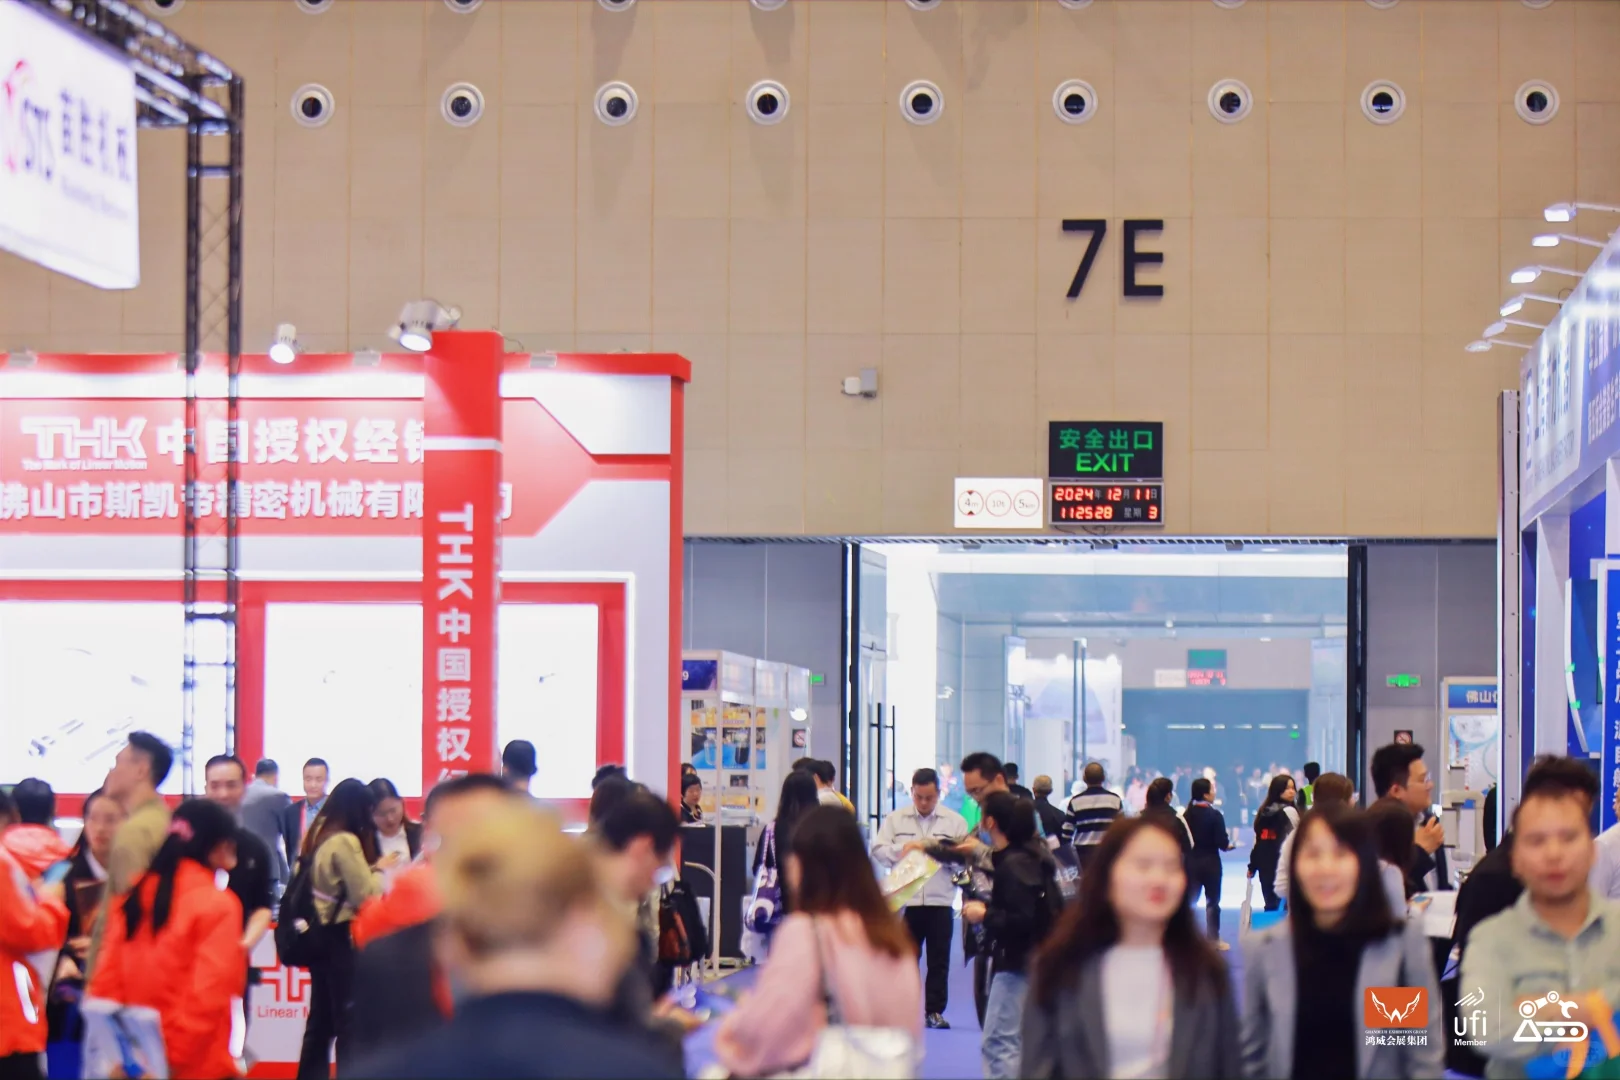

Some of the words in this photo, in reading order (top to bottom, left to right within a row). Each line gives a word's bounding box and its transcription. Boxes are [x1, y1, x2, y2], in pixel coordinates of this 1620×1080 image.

[21, 417, 147, 459] THK
[1060, 428, 1153, 450] 安全出口
[1076, 452, 1134, 472] EXIT
[258, 1005, 299, 1018] Linear
